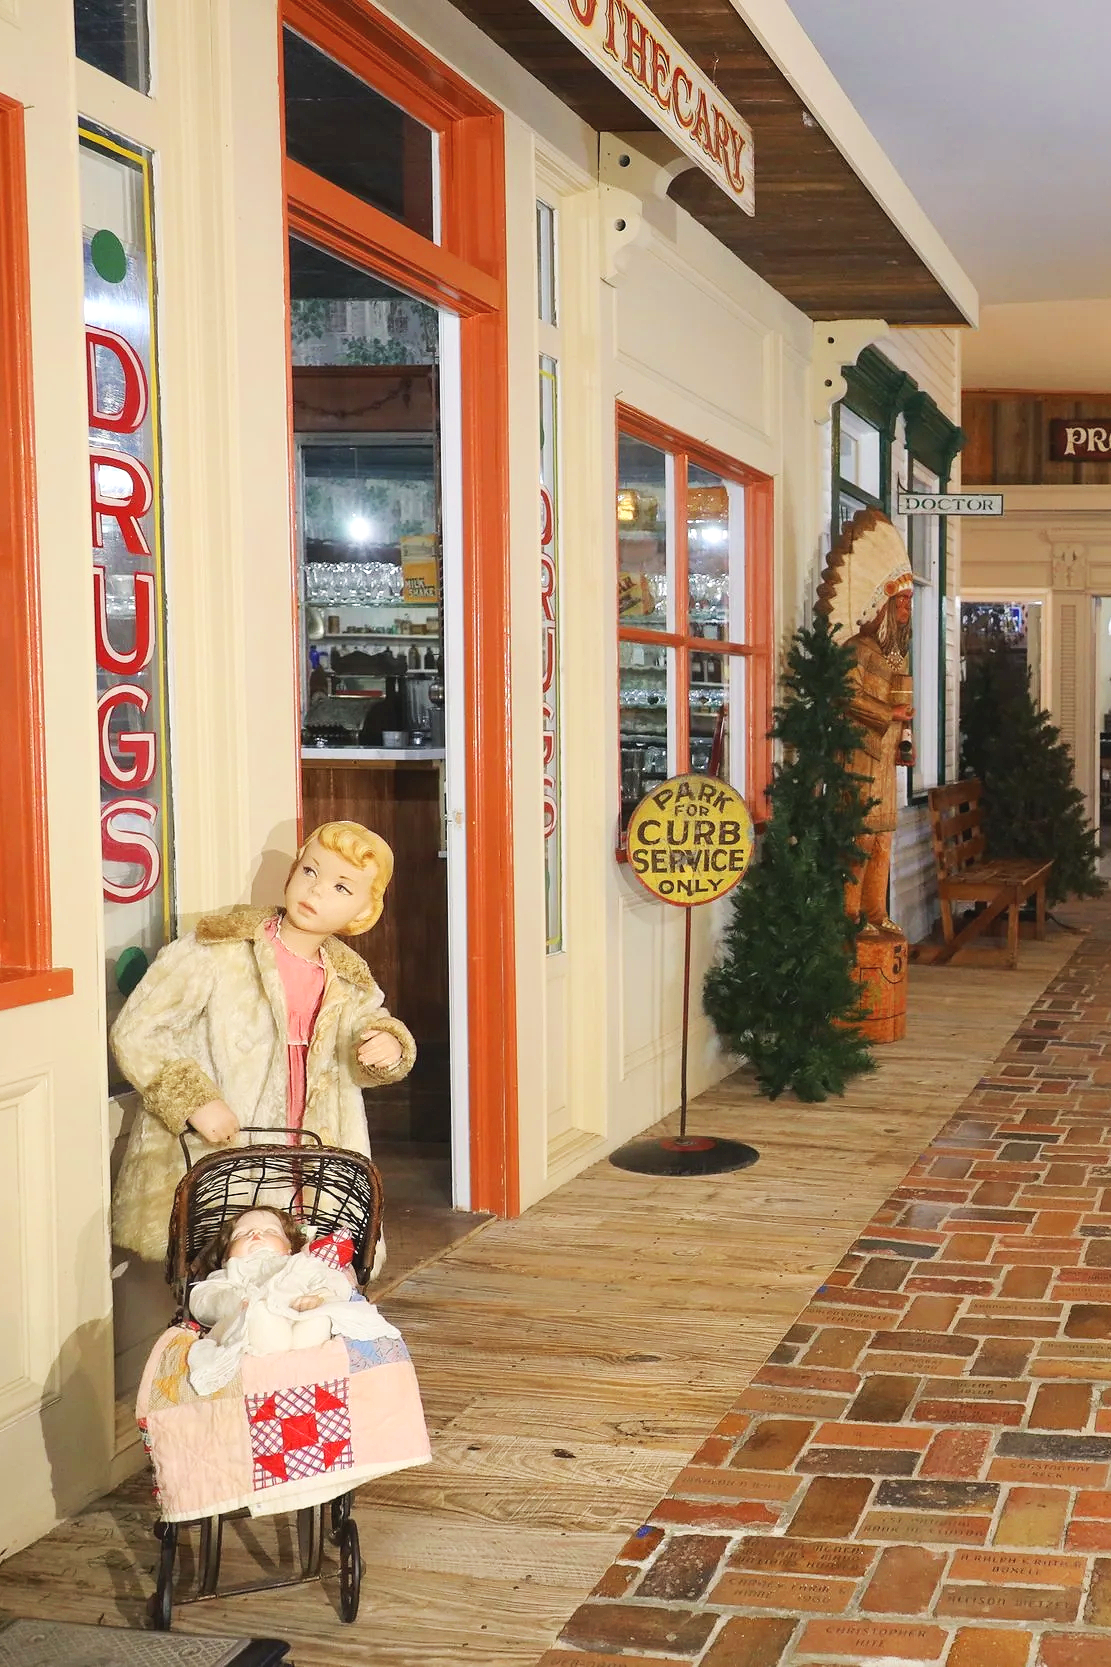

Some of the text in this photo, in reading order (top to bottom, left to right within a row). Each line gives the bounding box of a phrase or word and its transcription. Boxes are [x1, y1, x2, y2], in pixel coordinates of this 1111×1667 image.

[905, 496, 994, 513] DOCTOR
[85, 324, 161, 904] DRUGS
[652, 782, 734, 813] PARK
[674, 803, 709, 817] FOR
[637, 820, 741, 845] CURB
[632, 848, 744, 874] SERVICE
[658, 878, 724, 896] ONLY
[825, 1625, 927, 1638] CHRISTOPHER
